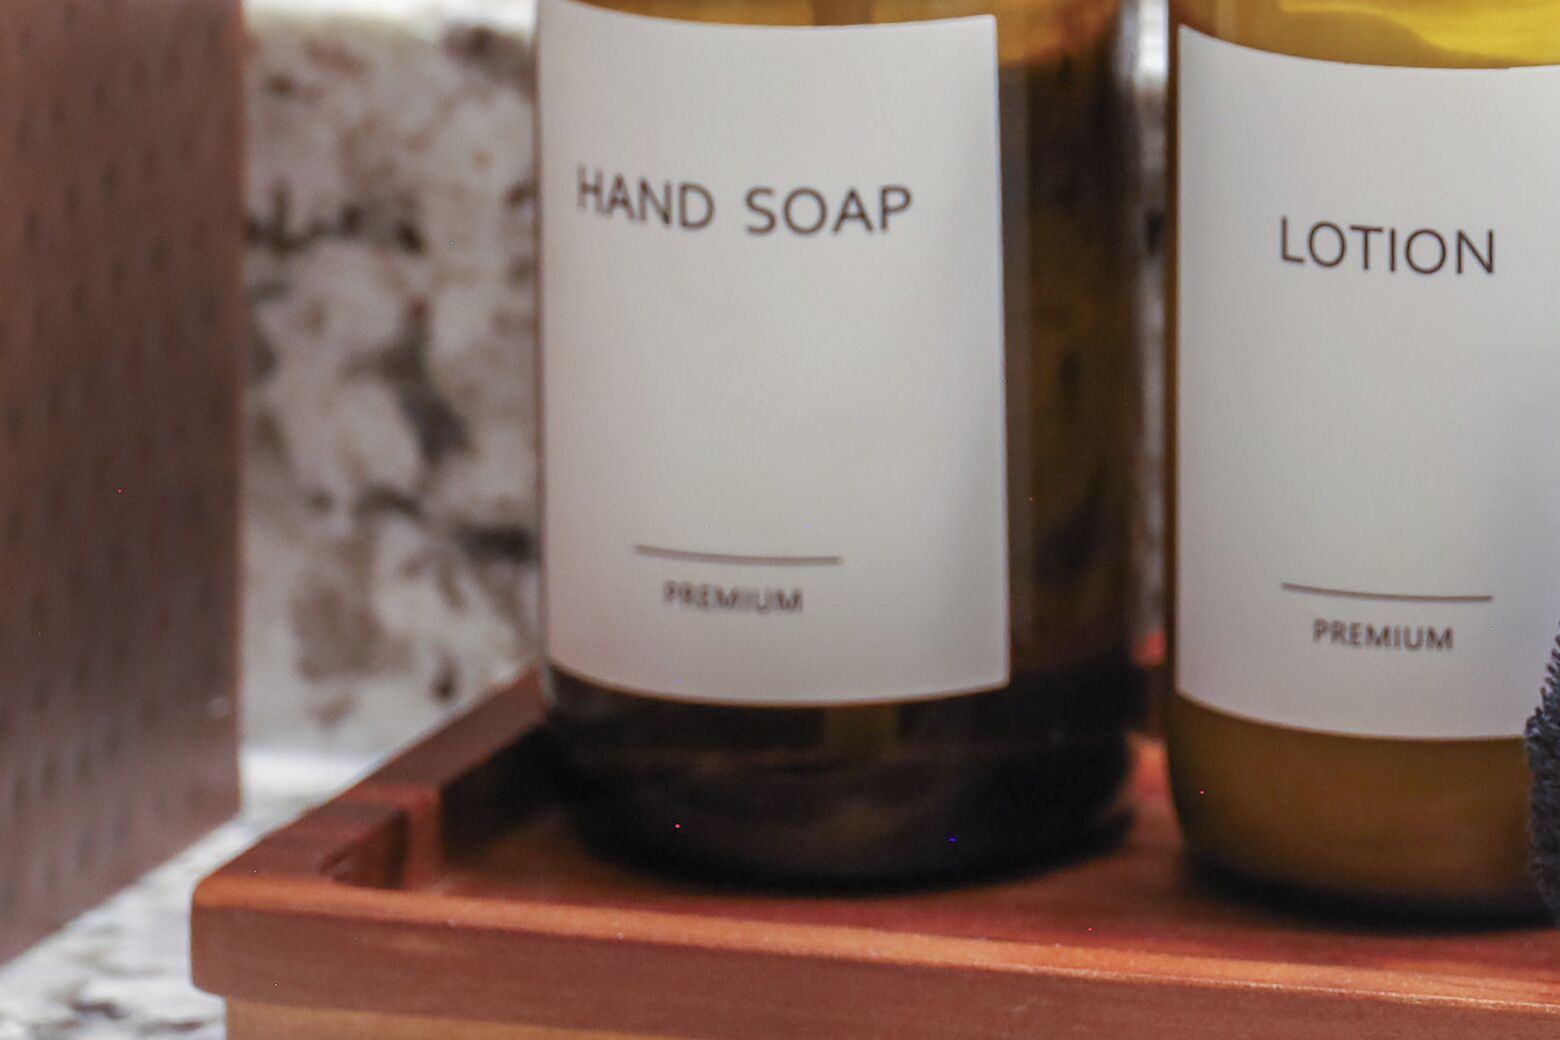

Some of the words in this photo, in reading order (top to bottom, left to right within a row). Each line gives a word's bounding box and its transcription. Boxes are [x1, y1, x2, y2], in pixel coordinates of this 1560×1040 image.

[577, 164, 715, 230] HAND
[744, 184, 913, 237] SOAP
[1280, 216, 1495, 276] LOTION
[664, 580, 803, 613] PREMIUM
[1313, 618, 1454, 650] PREMIUM
